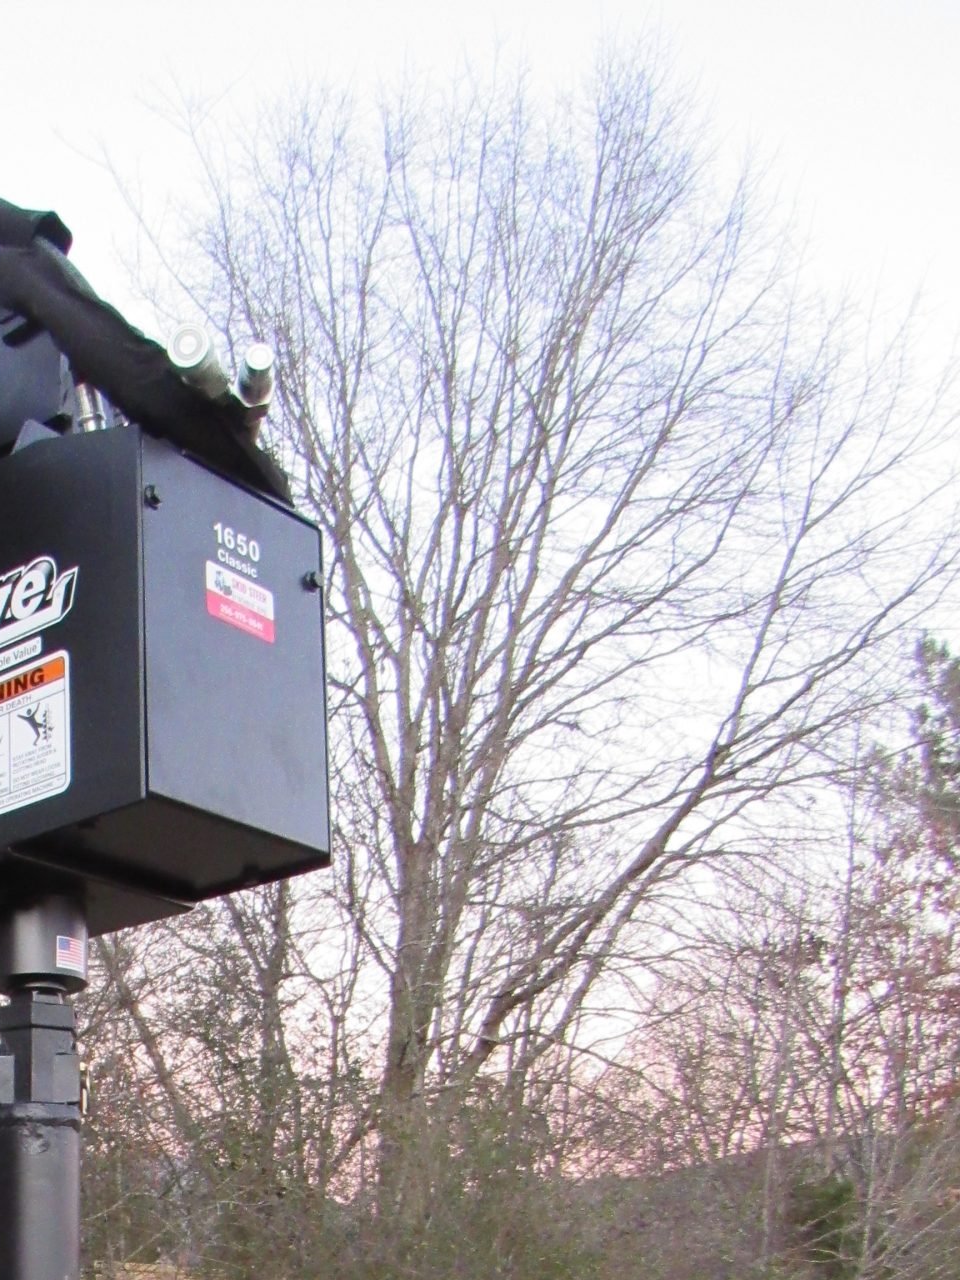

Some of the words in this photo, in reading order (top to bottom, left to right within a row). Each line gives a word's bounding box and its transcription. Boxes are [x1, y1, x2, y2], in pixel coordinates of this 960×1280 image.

[213, 522, 260, 562] 1650
[217, 548, 258, 578] Classic
[5, 695, 32, 714] DEATH
